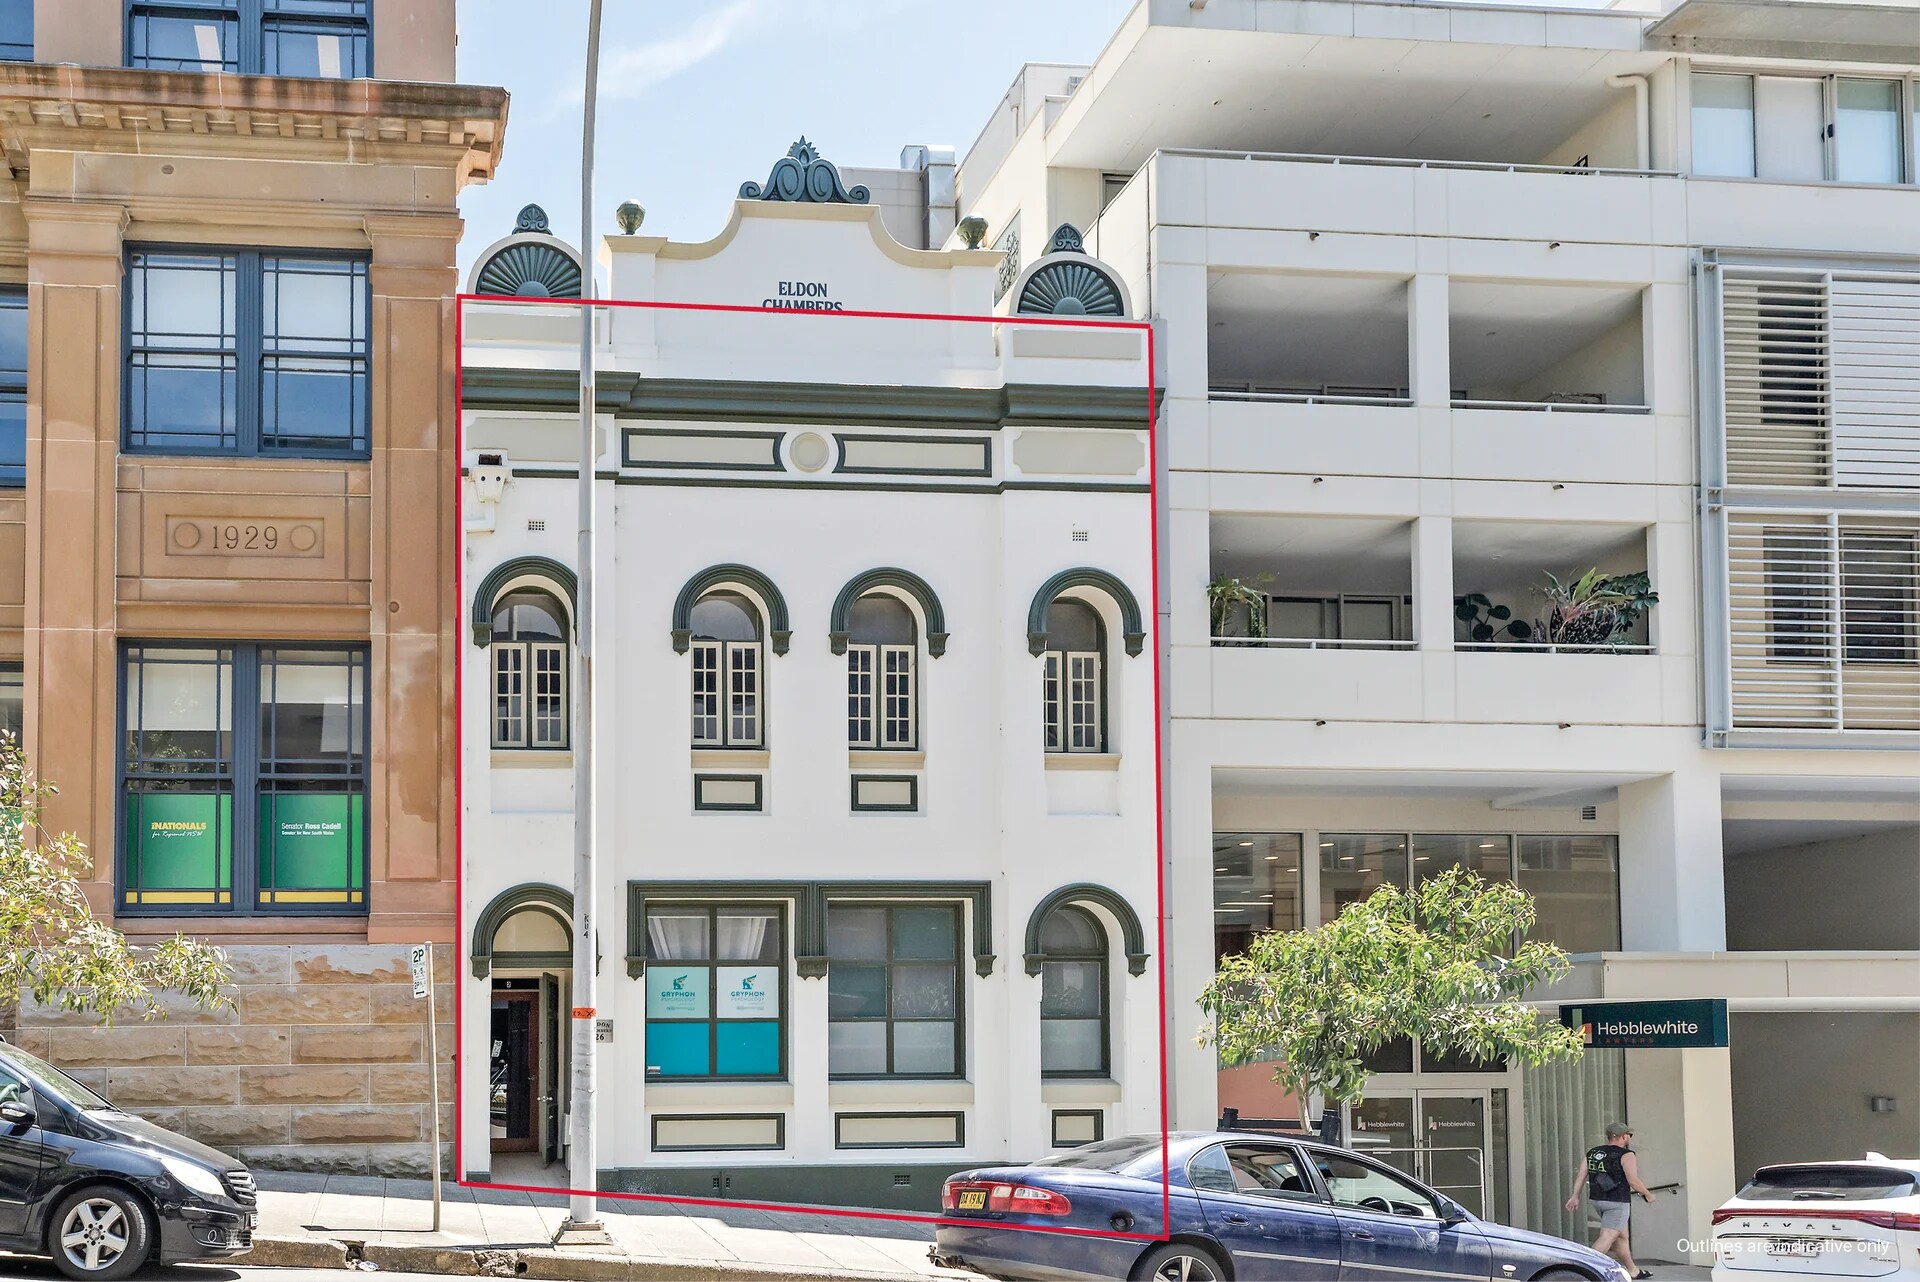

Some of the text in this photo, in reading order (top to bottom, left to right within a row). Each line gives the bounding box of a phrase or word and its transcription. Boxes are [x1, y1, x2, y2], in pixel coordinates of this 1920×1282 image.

[778, 281, 828, 297] ELDON
[212, 525, 278, 550] 1929
[281, 822, 342, 830] Senator Ross Cadell
[412, 949, 425, 963] 2P
[1597, 1020, 1699, 1036] Hebblewhite
[1367, 1120, 1405, 1128] Hebblewhite
[1438, 1120, 1476, 1128] Hebblewhite
[1742, 1221, 1842, 1231] HAVAL
